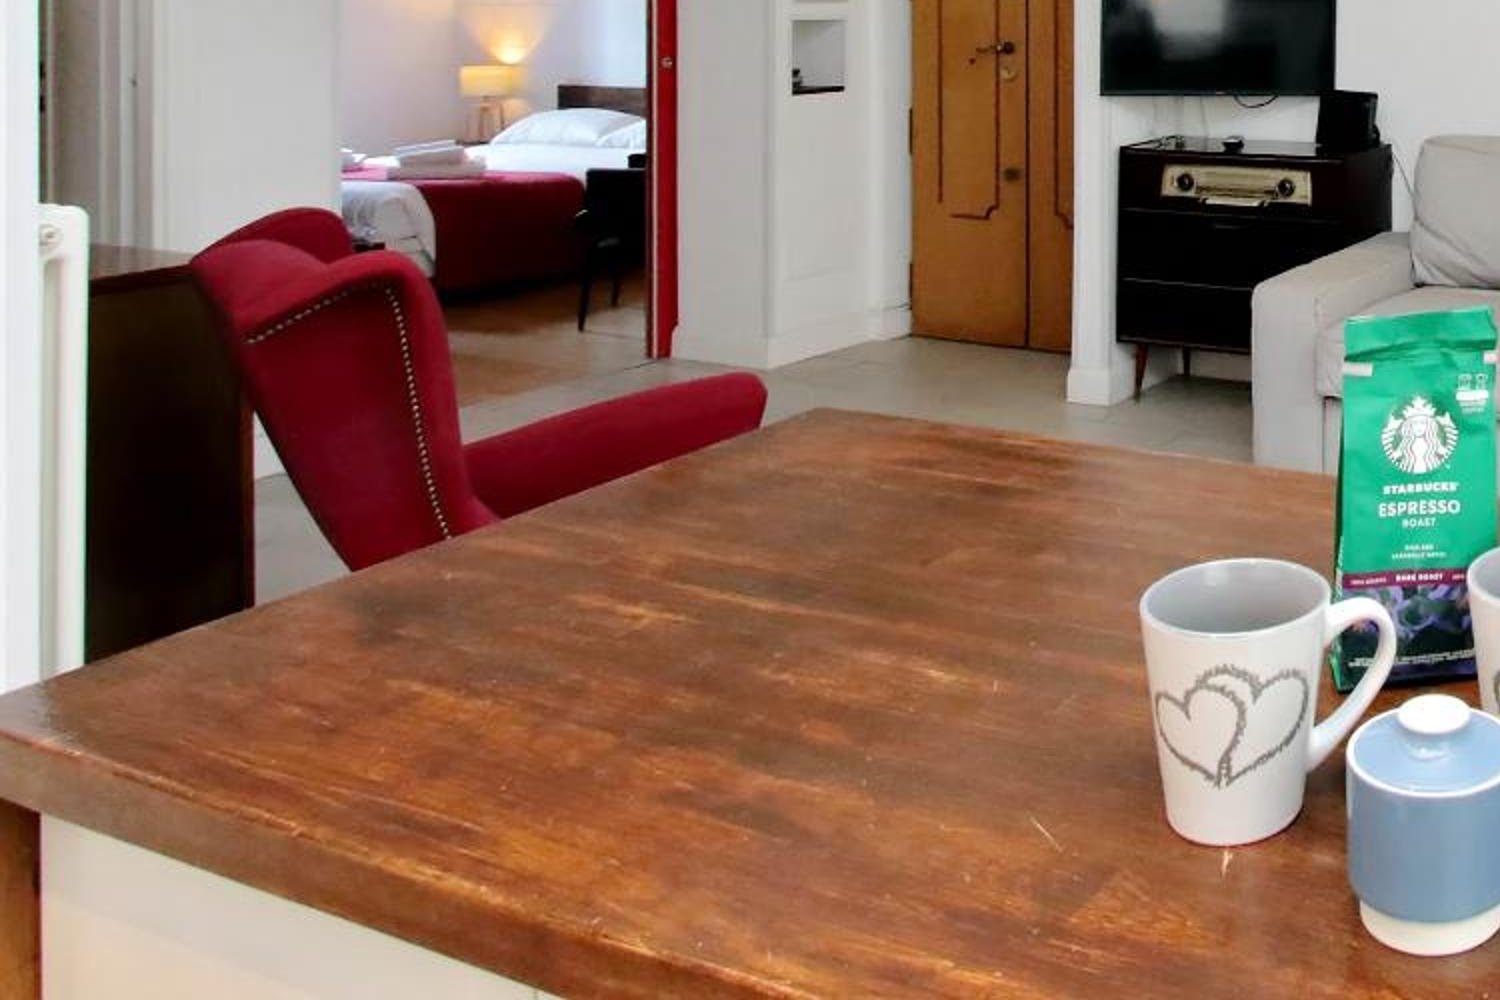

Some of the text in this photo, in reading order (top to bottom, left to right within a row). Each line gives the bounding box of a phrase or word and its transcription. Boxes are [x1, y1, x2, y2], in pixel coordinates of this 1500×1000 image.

[1383, 481, 1457, 495] STARBUCKS
[1379, 500, 1461, 517] ESPRESSO
[1402, 517, 1436, 528] ROAST
